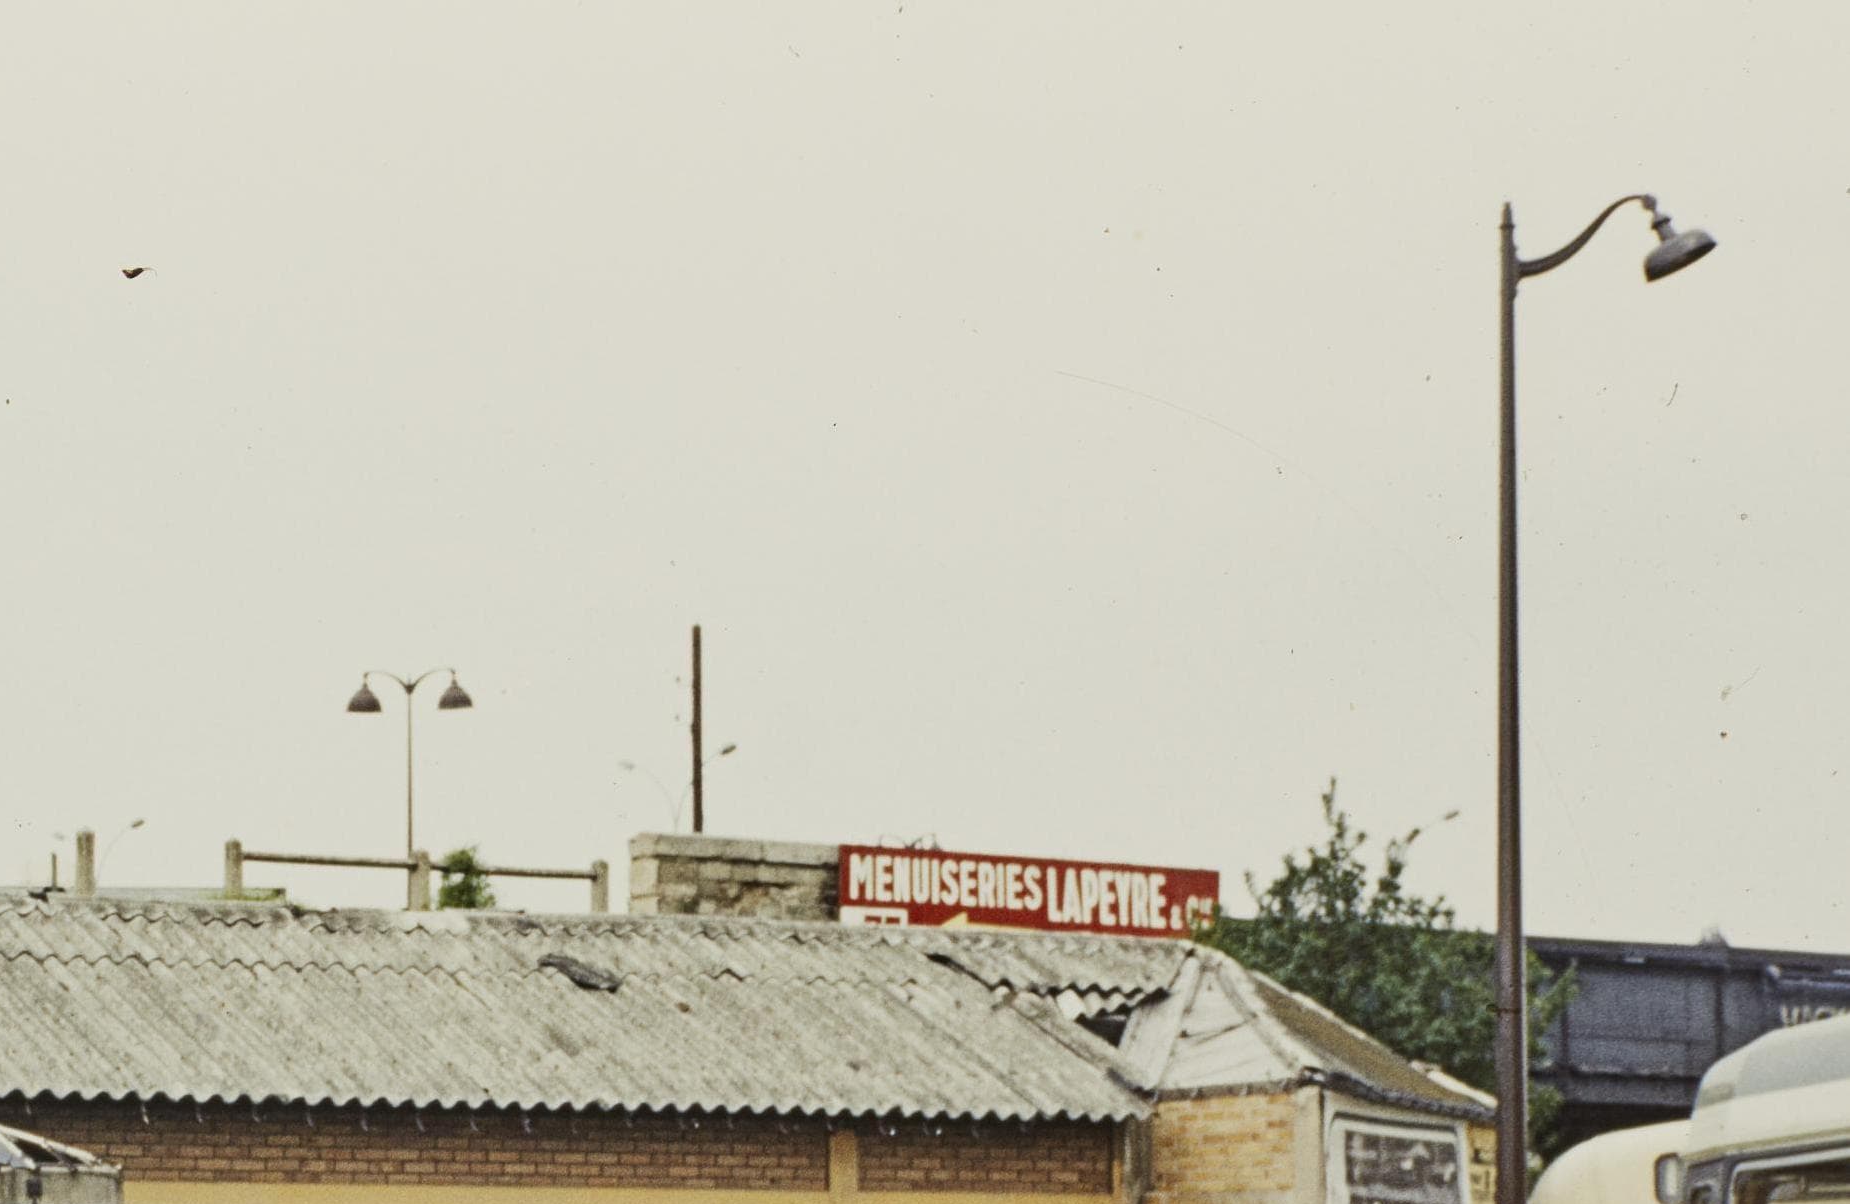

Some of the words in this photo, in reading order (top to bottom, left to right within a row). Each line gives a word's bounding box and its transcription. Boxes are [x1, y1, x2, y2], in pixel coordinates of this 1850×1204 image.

[849, 853, 1042, 911] MENUISERIES
[1046, 866, 1166, 929] LAPEYRE
[1170, 904, 1184, 930] &
